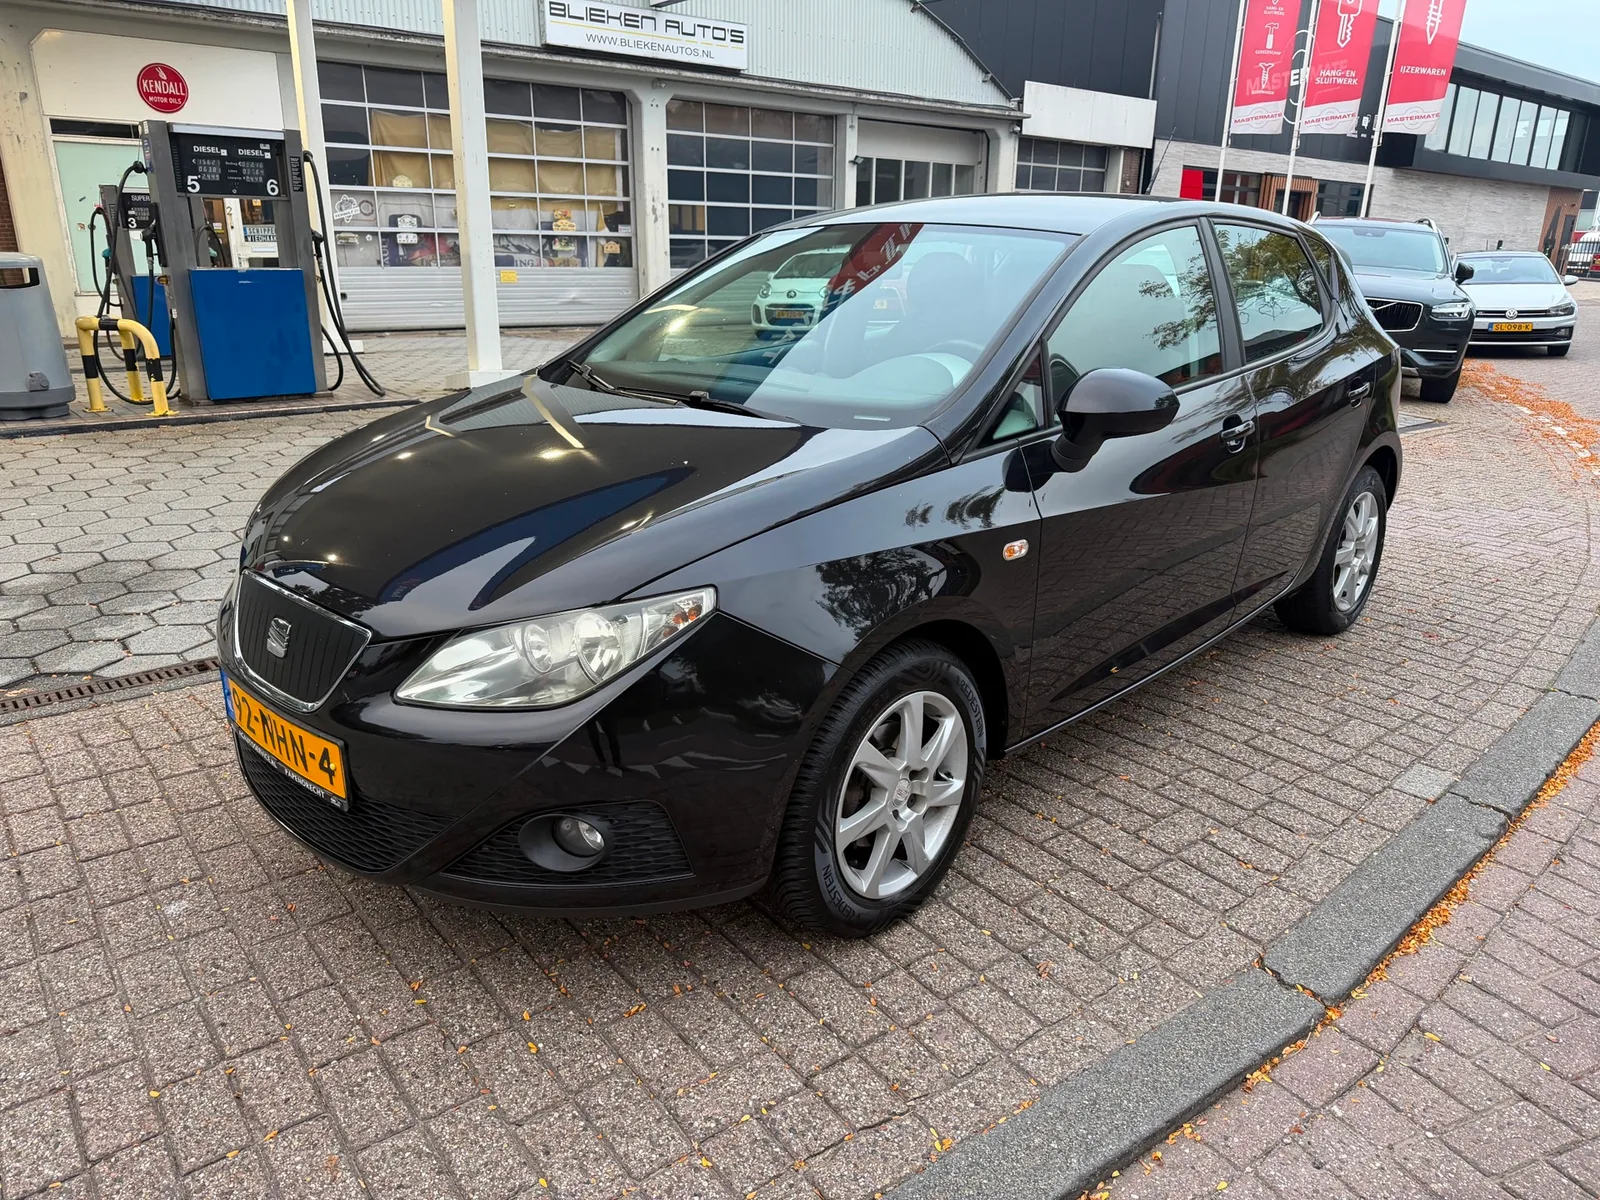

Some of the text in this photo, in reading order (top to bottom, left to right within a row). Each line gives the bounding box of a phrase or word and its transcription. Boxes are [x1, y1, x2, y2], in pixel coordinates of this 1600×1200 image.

[549, 1, 744, 44] BLIEKEN AUTO'S
[586, 33, 715, 59] WWW.BLIEKENAUTOS.NL
[1319, 69, 1345, 77] HANG-
[1400, 65, 1447, 76] IJZERWAREN
[1315, 77, 1358, 85] SLUITWERK
[142, 79, 185, 96] KENDALL
[148, 96, 182, 105] MOTOR OILS
[1234, 112, 1283, 124] MASTERMATE
[1304, 112, 1357, 125] MASTERMATE
[1387, 112, 1440, 123] MASTERMATE
[193, 145, 221, 154] DIESEL
[238, 148, 264, 157] DIESEL
[186, 175, 201, 193] 5
[266, 178, 279, 196] 6
[131, 194, 151, 202] SUPER
[128, 217, 137, 229] 3
[232, 687, 337, 786] 92-NHN-4
[284, 768, 326, 799] PAPENDRECHT
